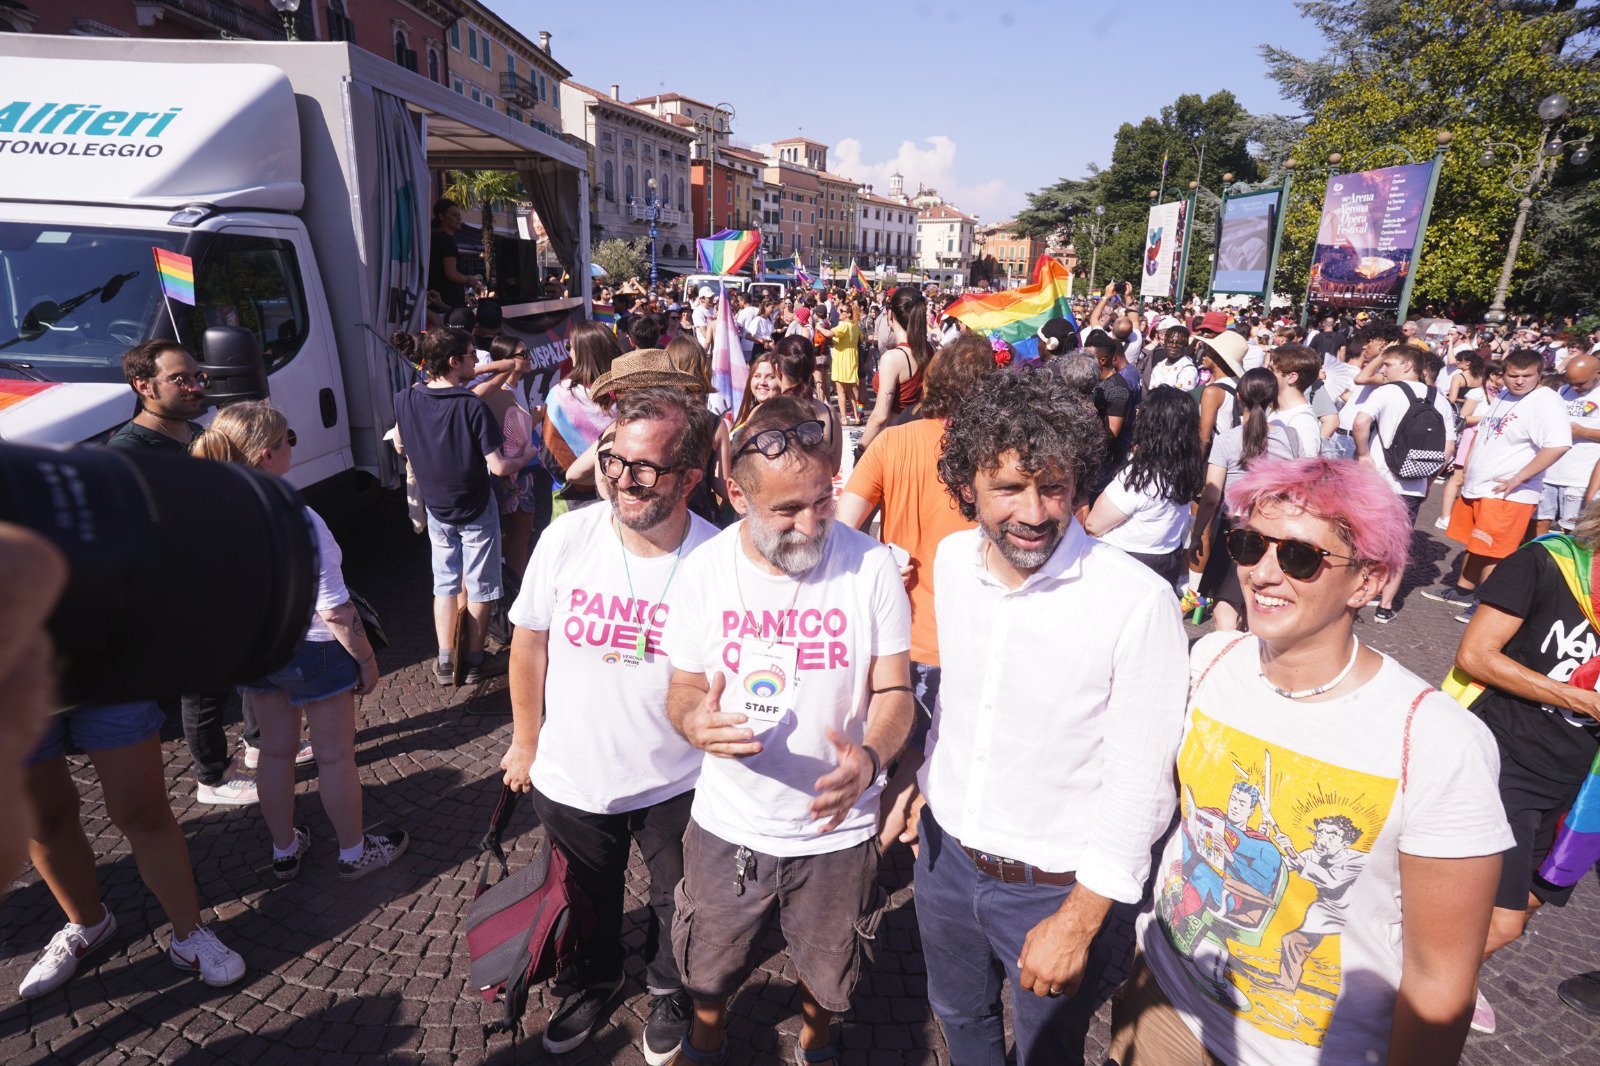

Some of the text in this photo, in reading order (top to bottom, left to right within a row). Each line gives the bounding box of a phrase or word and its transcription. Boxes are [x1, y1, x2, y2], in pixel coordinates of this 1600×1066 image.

[0, 101, 183, 138] Alfieri
[569, 588, 670, 628] PANIC
[722, 608, 847, 638] PANICO
[722, 641, 849, 674] QER
[745, 702, 779, 714] STAFF
